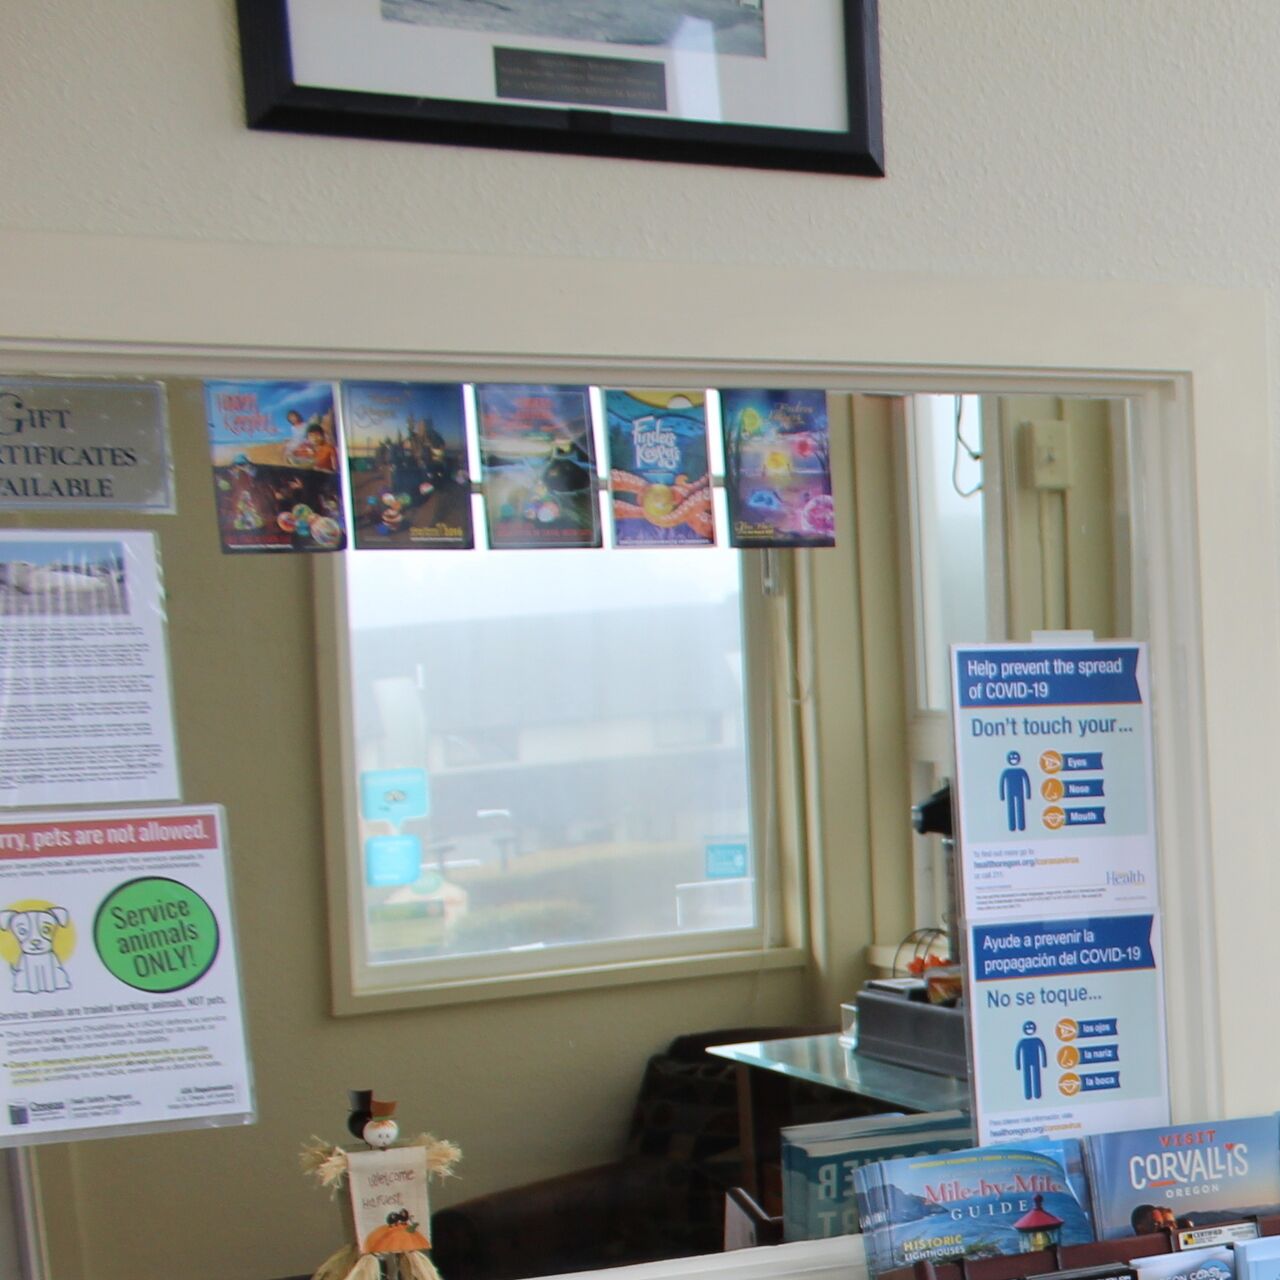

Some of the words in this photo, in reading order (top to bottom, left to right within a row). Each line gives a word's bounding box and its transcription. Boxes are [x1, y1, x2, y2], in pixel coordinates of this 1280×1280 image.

[0, 393, 71, 436] GIFT
[0, 445, 138, 466] TIFICATES
[0, 477, 113, 497] AILABLE
[968, 660, 997, 678] Help
[1001, 660, 1049, 678] prevent
[1053, 659, 1074, 674] the
[1078, 658, 1122, 676] spread
[969, 683, 982, 699] of
[986, 682, 1048, 698] COVID-19
[972, 717, 1017, 736] Don't
[1024, 716, 1072, 736] touch
[1079, 718, 1133, 737] your...
[1067, 757, 1087, 768] Eyes
[1069, 784, 1090, 794] Nose
[1070, 811, 1097, 821] Mouth
[33, 827, 71, 850] pets
[77, 828, 103, 844] are
[108, 824, 136, 843] not
[139, 820, 209, 842] allowed.
[1106, 871, 1145, 885] Health
[111, 899, 190, 930] Service
[116, 920, 199, 954] animals
[983, 933, 1020, 951] Ayude
[1023, 936, 1031, 947] a
[1034, 930, 1080, 949] prevenir
[1083, 929, 1095, 942] la
[134, 945, 198, 978] ONLY!
[984, 955, 1057, 974] propagación
[1059, 952, 1077, 967] del
[1080, 946, 1141, 964] COVID-19
[987, 989, 1011, 1008] No
[1016, 990, 1035, 1006] se
[1040, 987, 1102, 1007] toque...
[1159, 1130, 1216, 1147] VISIT
[923, 1174, 1062, 1205] Mile-by-Mile
[1165, 1184, 1219, 1199] OREGON
[951, 1200, 1028, 1221] GUIDE
[904, 1234, 962, 1251] HISTORIC
[904, 1246, 965, 1261] LIGHTHOUSES
